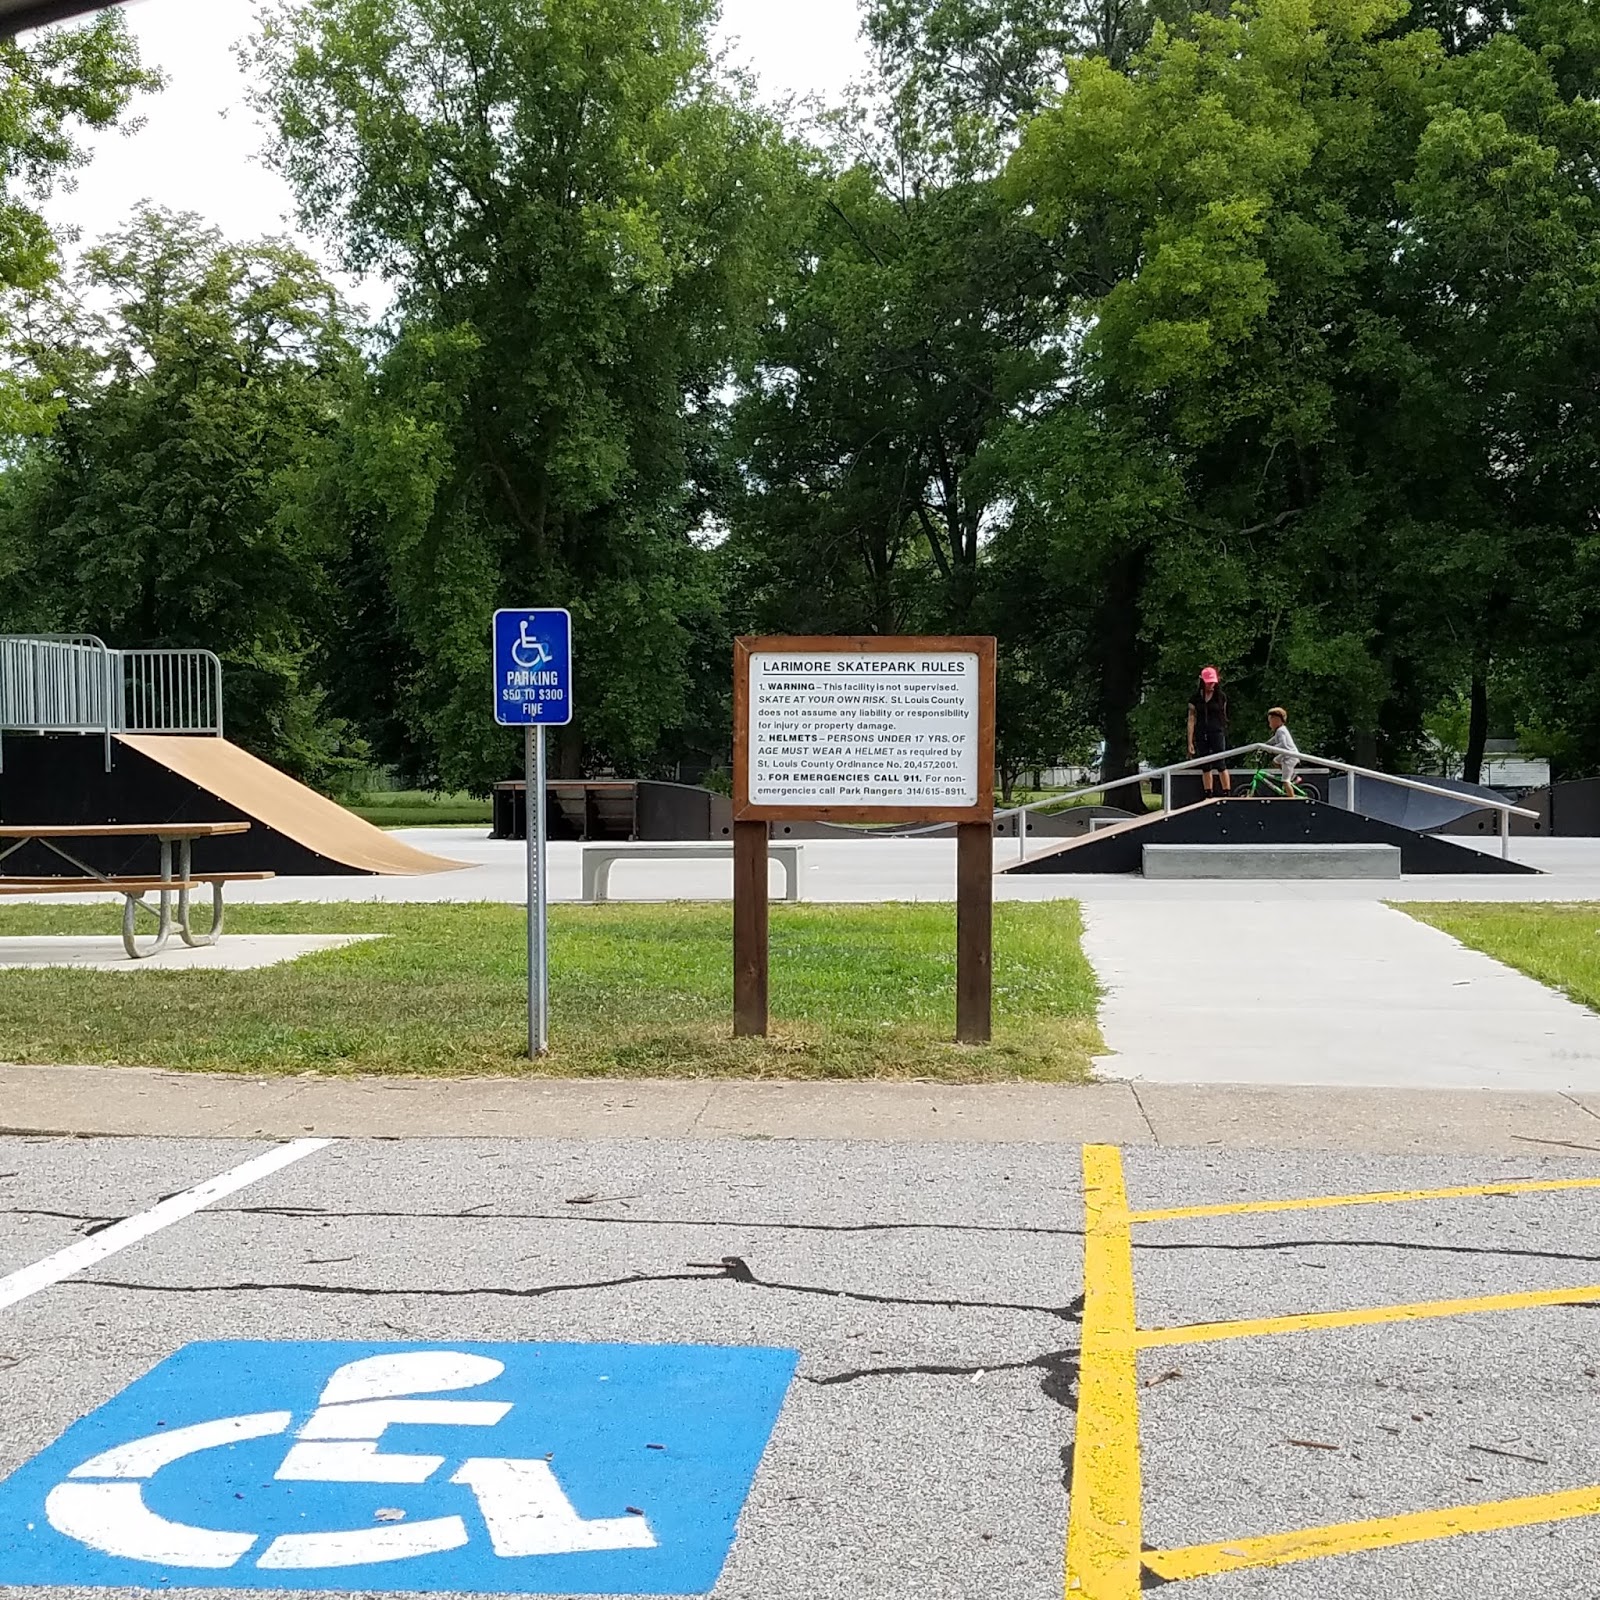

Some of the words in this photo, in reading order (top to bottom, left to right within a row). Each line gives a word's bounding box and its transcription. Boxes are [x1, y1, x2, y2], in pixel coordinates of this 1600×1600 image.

[763, 662, 831, 671] LARIMORE
[837, 662, 916, 672] SKATEPARK
[922, 662, 965, 672] RULES
[507, 671, 558, 685] PARKING
[844, 683, 875, 692] facility
[904, 683, 959, 693] supervised.
[503, 689, 521, 700] $50
[525, 689, 535, 700] TO
[539, 689, 563, 700] $300
[759, 695, 791, 703] SKATE
[793, 695, 805, 703] AT
[808, 695, 835, 703] YOUR
[862, 696, 888, 704] RISK.
[905, 696, 929, 704] Louis
[931, 696, 964, 705] County
[523, 703, 543, 714] FINE
[859, 709, 892, 718] liability
[907, 709, 969, 718] responsibility
[758, 721, 771, 729] for
[774, 721, 799, 731] injury
[814, 722, 854, 731] property
[857, 722, 896, 731] damage.
[928, 735, 950, 743] YRS.
[952, 735, 966, 743] OF
[812, 747, 842, 755] WEAR
[845, 747, 851, 755] A
[855, 747, 895, 755] HELMET
[910, 748, 948, 757] required
[950, 748, 962, 758] by
[757, 760, 769, 768] St.
[773, 760, 797, 768] Louis
[800, 760, 834, 770] County
[836, 760, 884, 769] Ordinance
[886, 761, 901, 769] No.
[793, 774, 870, 782] EMERGENCIES
[758, 787, 816, 796] emergencies
[819, 787, 835, 795] call
[839, 787, 861, 795] Park
[863, 787, 903, 796] Rangers
